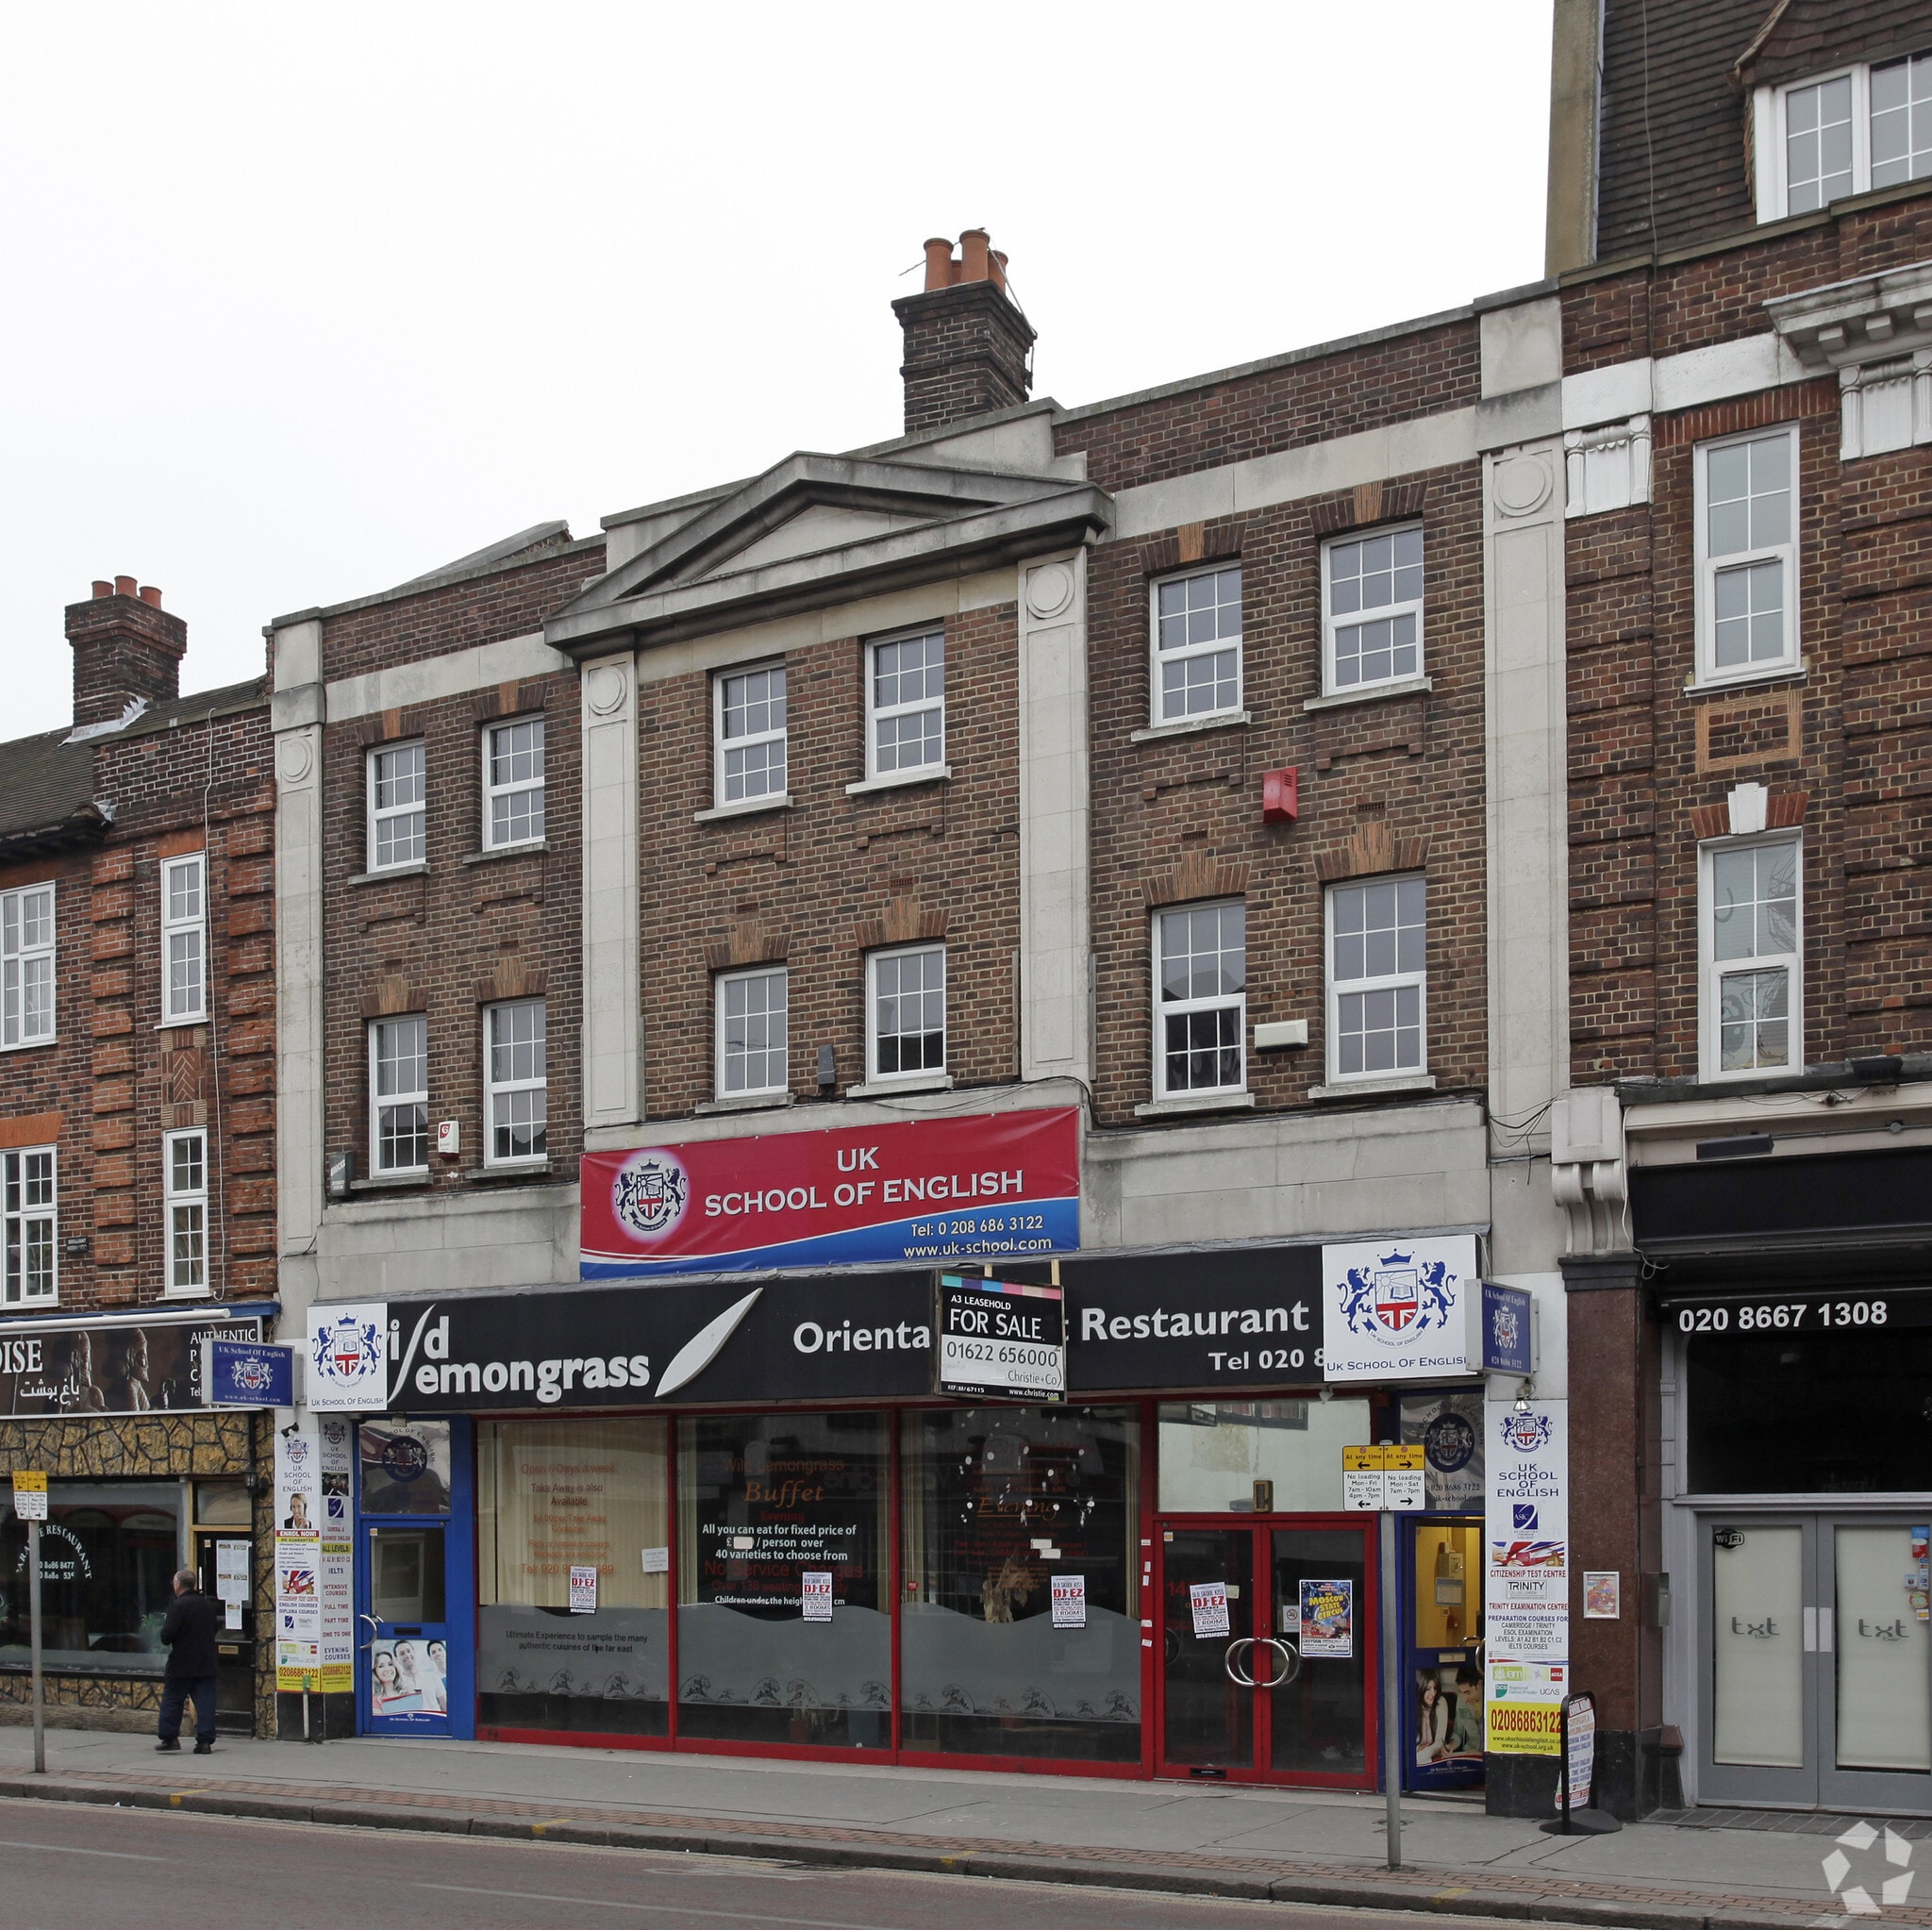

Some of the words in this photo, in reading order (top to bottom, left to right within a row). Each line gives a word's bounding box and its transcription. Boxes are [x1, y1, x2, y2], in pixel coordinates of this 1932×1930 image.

[837, 1147, 879, 1172] UK
[705, 1186, 827, 1217] SCHOOL
[834, 1181, 875, 1206] OF
[883, 1170, 1024, 1203] ENGLISH
[911, 1223, 934, 1238] Tel:
[938, 1222, 947, 1236] 0
[951, 1220, 975, 1235] 208
[980, 1218, 1005, 1232] 686
[1009, 1215, 1043, 1230] 3122
[904, 1238, 1052, 1257] www.uk-school.com
[965, 1296, 1011, 1309] LEASEHOLD
[951, 1308, 989, 1334] FOR
[1679, 1308, 1728, 1332] 020
[1739, 1305, 1807, 1329] 8667
[1819, 1301, 1887, 1325] 1308
[793, 1321, 930, 1353] Orienta
[1082, 1301, 1309, 1340] Restaurant
[0, 1339, 43, 1373] ISE
[262, 1350, 285, 1358] English
[947, 1341, 993, 1361] 01622
[999, 1347, 1057, 1367] 656000
[1208, 1352, 1249, 1370] Tel
[1258, 1349, 1304, 1369] 020
[1008, 1371, 1039, 1383] Christie
[1009, 1389, 1058, 1397] www.christie.com
[1499, 1472, 1557, 1480] SCHOOL
[531, 1484, 550, 1492] Take
[553, 1484, 575, 1494] Away
[587, 1483, 603, 1491] also
[1519, 1480, 1537, 1489] OF
[744, 1480, 824, 1508] Buffet
[1498, 1489, 1558, 1497] ENGLISH
[551, 1497, 588, 1506] Available
[760, 1511, 805, 1522] Evening
[703, 1524, 715, 1534] All
[718, 1526, 735, 1536] you
[757, 1526, 772, 1535] eat
[774, 1524, 789, 1535] for
[791, 1524, 816, 1535] fixed
[819, 1525, 843, 1537] price
[845, 1524, 857, 1536] of
[716, 1550, 727, 1558] 40
[730, 1550, 771, 1559] varieties
[774, 1551, 784, 1559] to
[787, 1550, 821, 1560] choose
[824, 1550, 848, 1560] from
[705, 1560, 725, 1575] No
[731, 1560, 790, 1576] Service
[1508, 1582, 1544, 1590] TRINITY
[770, 1596, 783, 1605] the
[784, 1597, 803, 1606] heig
[1211, 1596, 1224, 1606] EZ
[1309, 1595, 1344, 1606] MOSCOW
[1320, 1603, 1340, 1611] STATE
[1318, 1607, 1342, 1621] CIRCUS
[506, 1630, 534, 1639] Ultimate
[536, 1631, 575, 1640] Experience
[587, 1633, 612, 1641] sample
[1491, 1709, 1561, 1733] 02086863122
